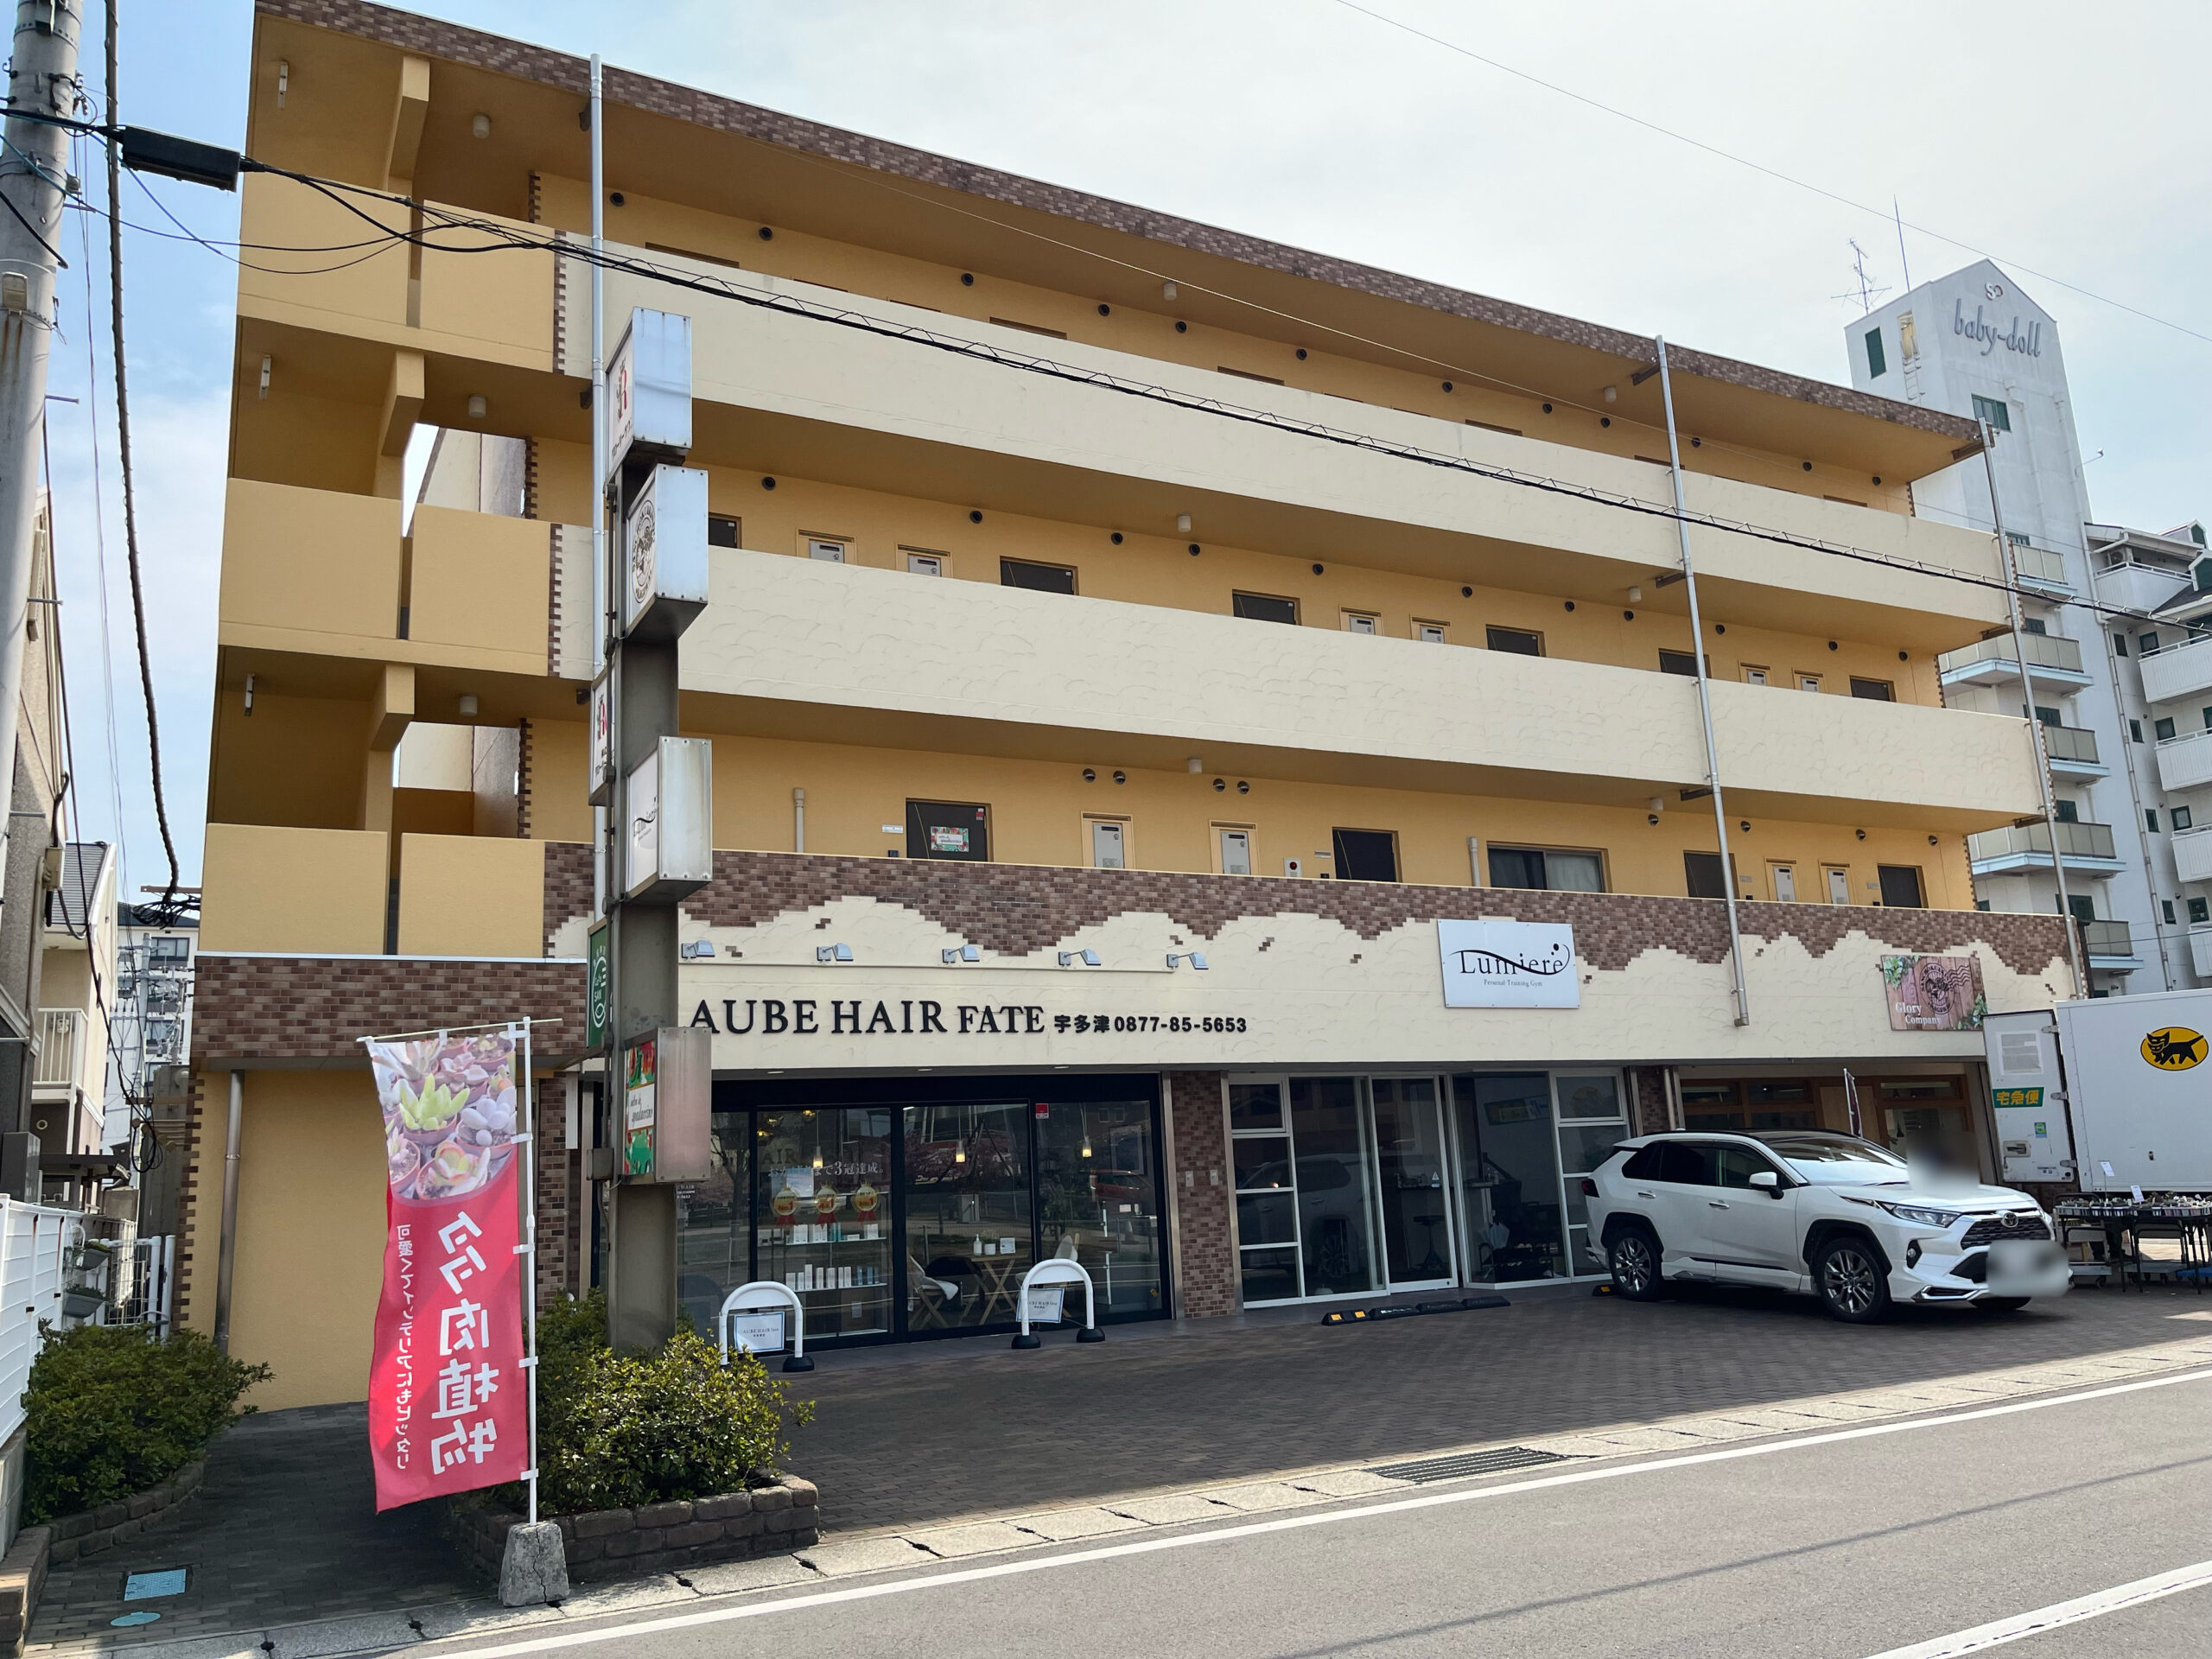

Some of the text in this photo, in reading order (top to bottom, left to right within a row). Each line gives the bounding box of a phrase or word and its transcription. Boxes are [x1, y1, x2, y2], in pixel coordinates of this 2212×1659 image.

[1954, 298, 2042, 358] baby-doll
[690, 999, 1247, 1034] AUBE HAIR FATE 宇多津 0877-85-5653
[1895, 1002, 1922, 1015] Glory
[1904, 1014, 1942, 1027] Company
[1996, 1090, 2039, 1106] 宅急便
